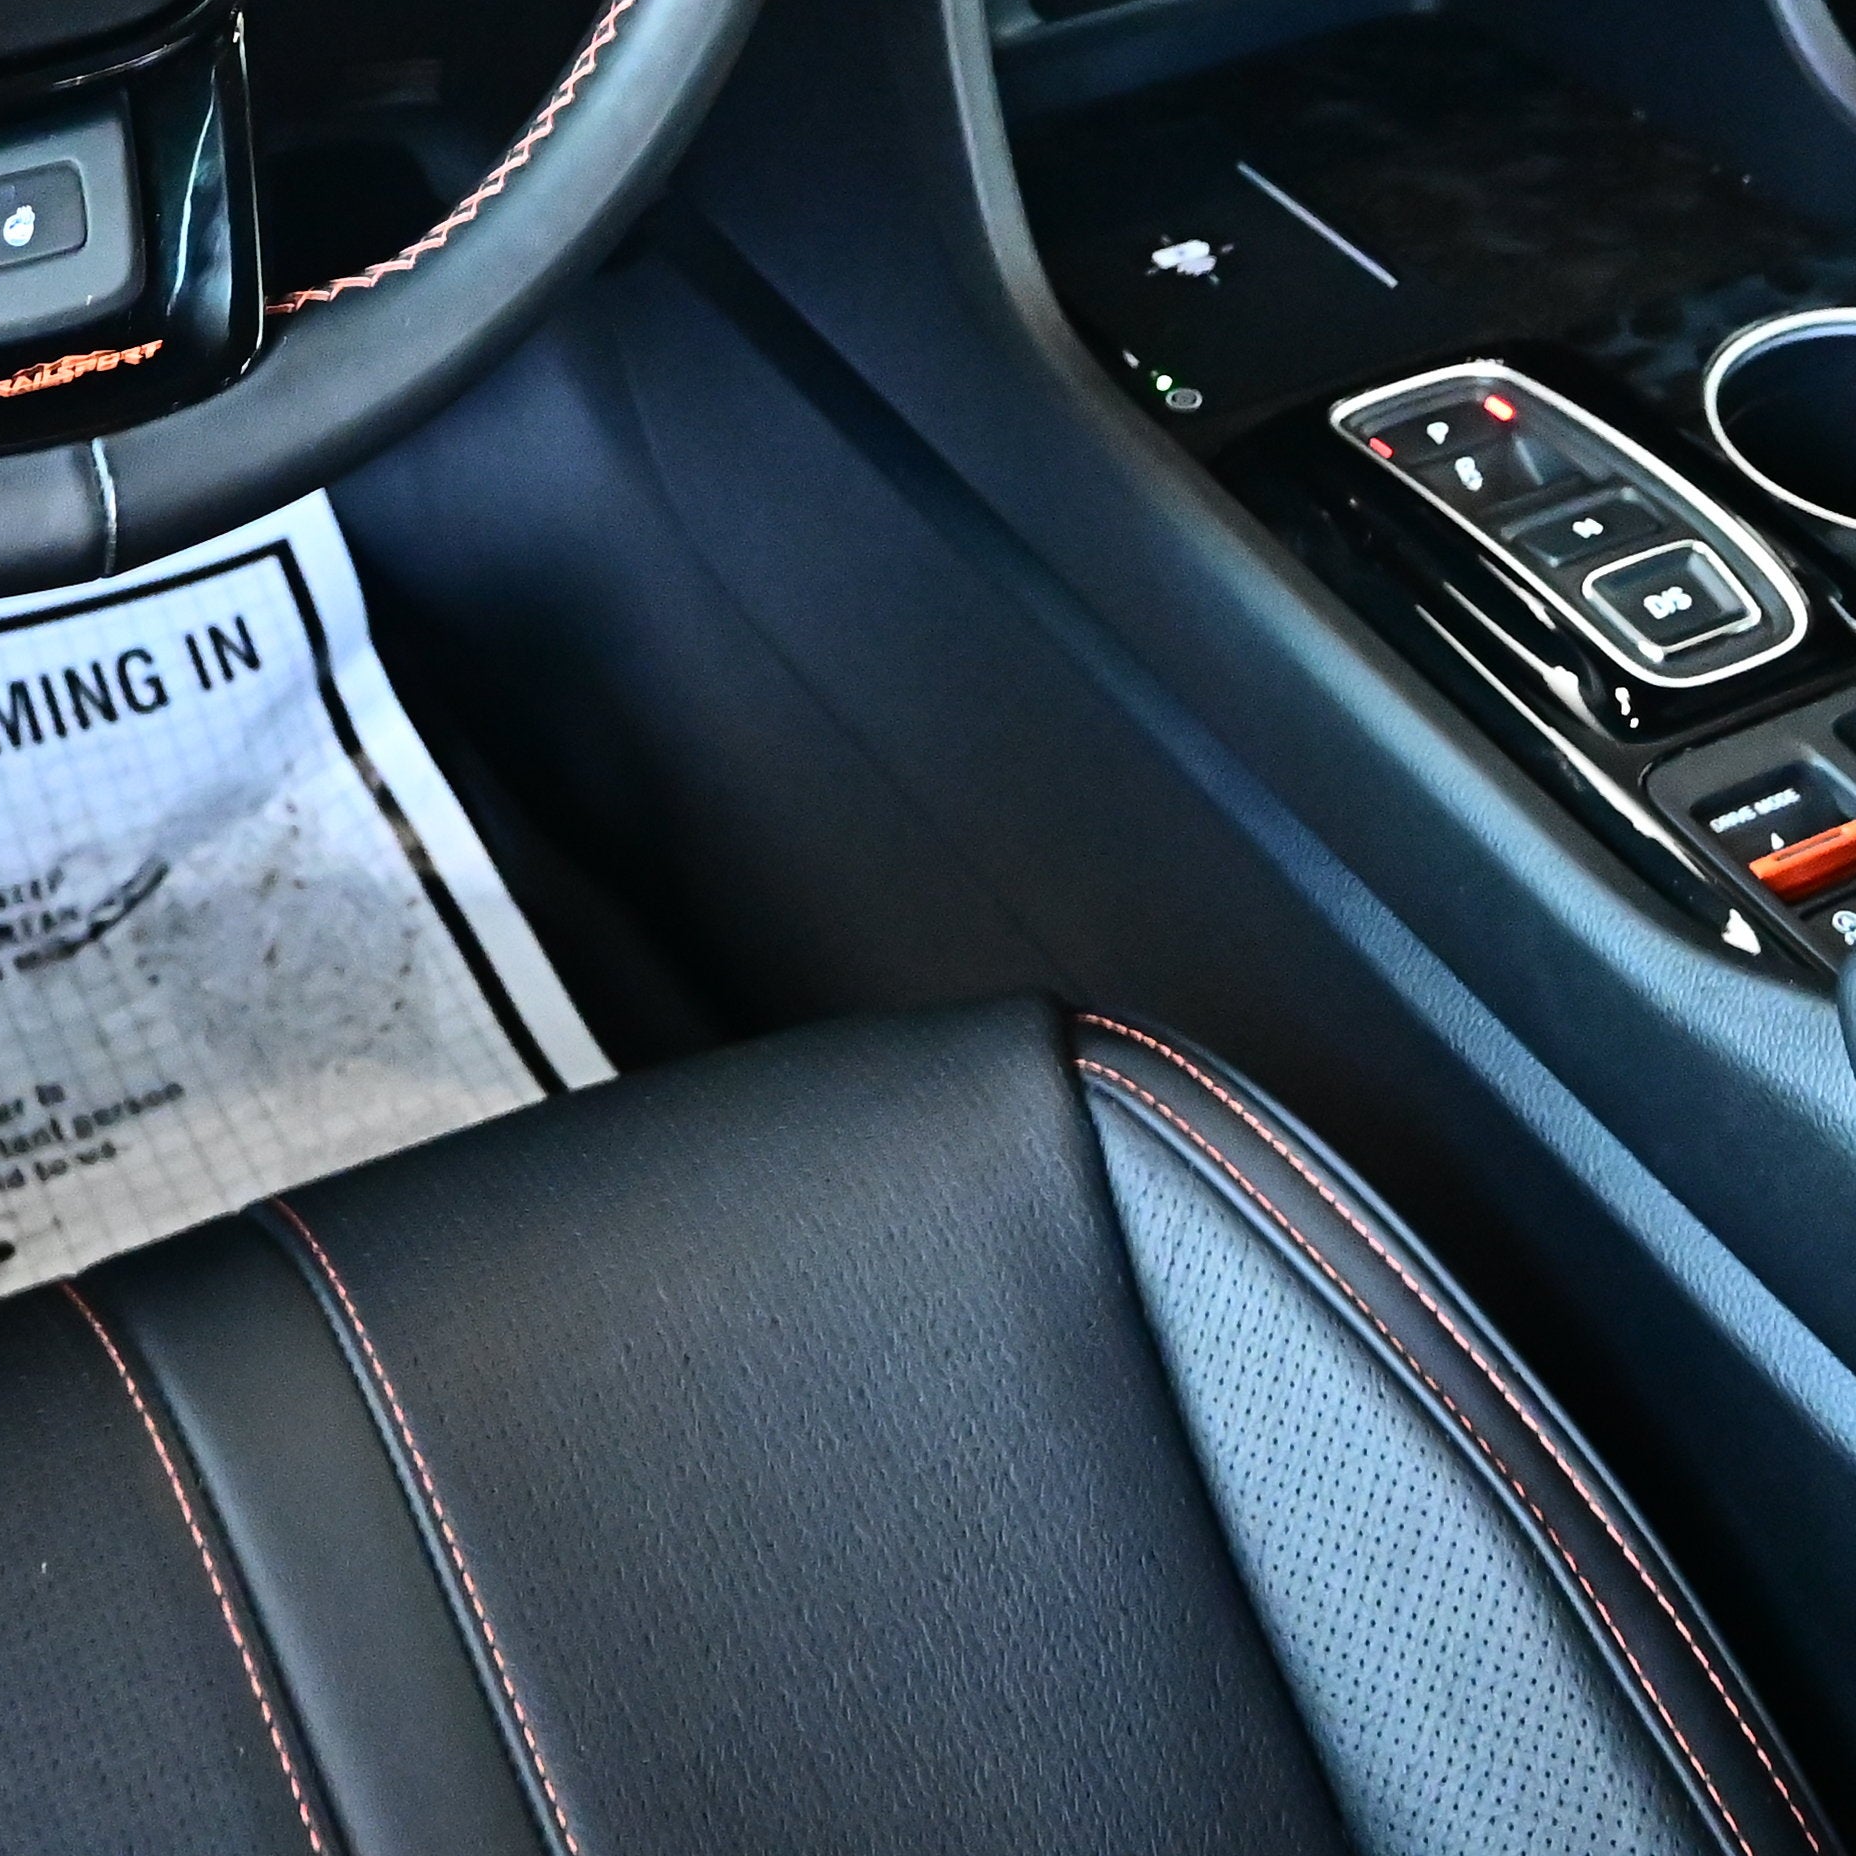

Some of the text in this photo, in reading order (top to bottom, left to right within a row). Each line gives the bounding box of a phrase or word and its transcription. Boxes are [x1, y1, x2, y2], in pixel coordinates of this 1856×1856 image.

[1643, 585, 1693, 620] D/S
[183, 613, 265, 692] IN
[33, 1156, 69, 1183] to
